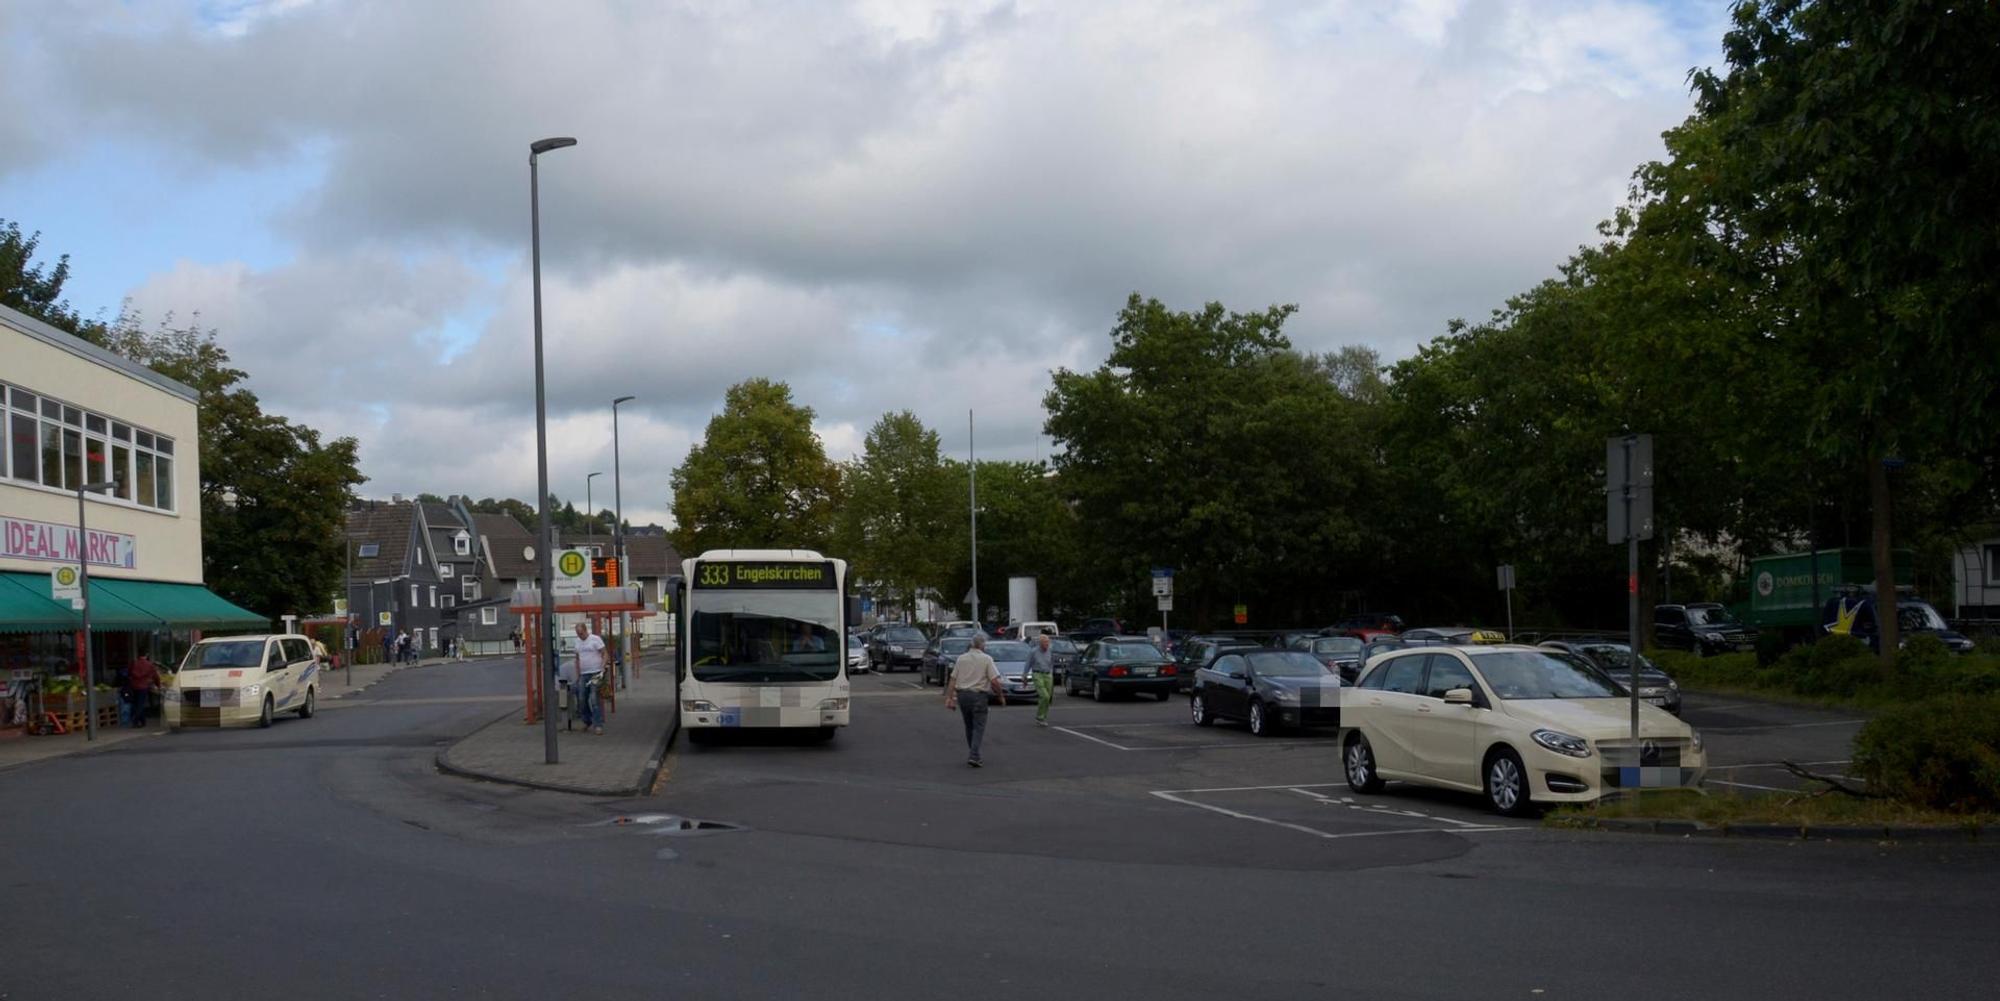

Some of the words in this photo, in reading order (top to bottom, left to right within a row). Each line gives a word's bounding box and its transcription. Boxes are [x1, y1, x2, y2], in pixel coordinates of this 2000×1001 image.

[5, 520, 60, 558] IDEAL
[566, 556, 578, 571] H
[700, 564, 729, 585] 333
[736, 565, 822, 583] Engelskirchen
